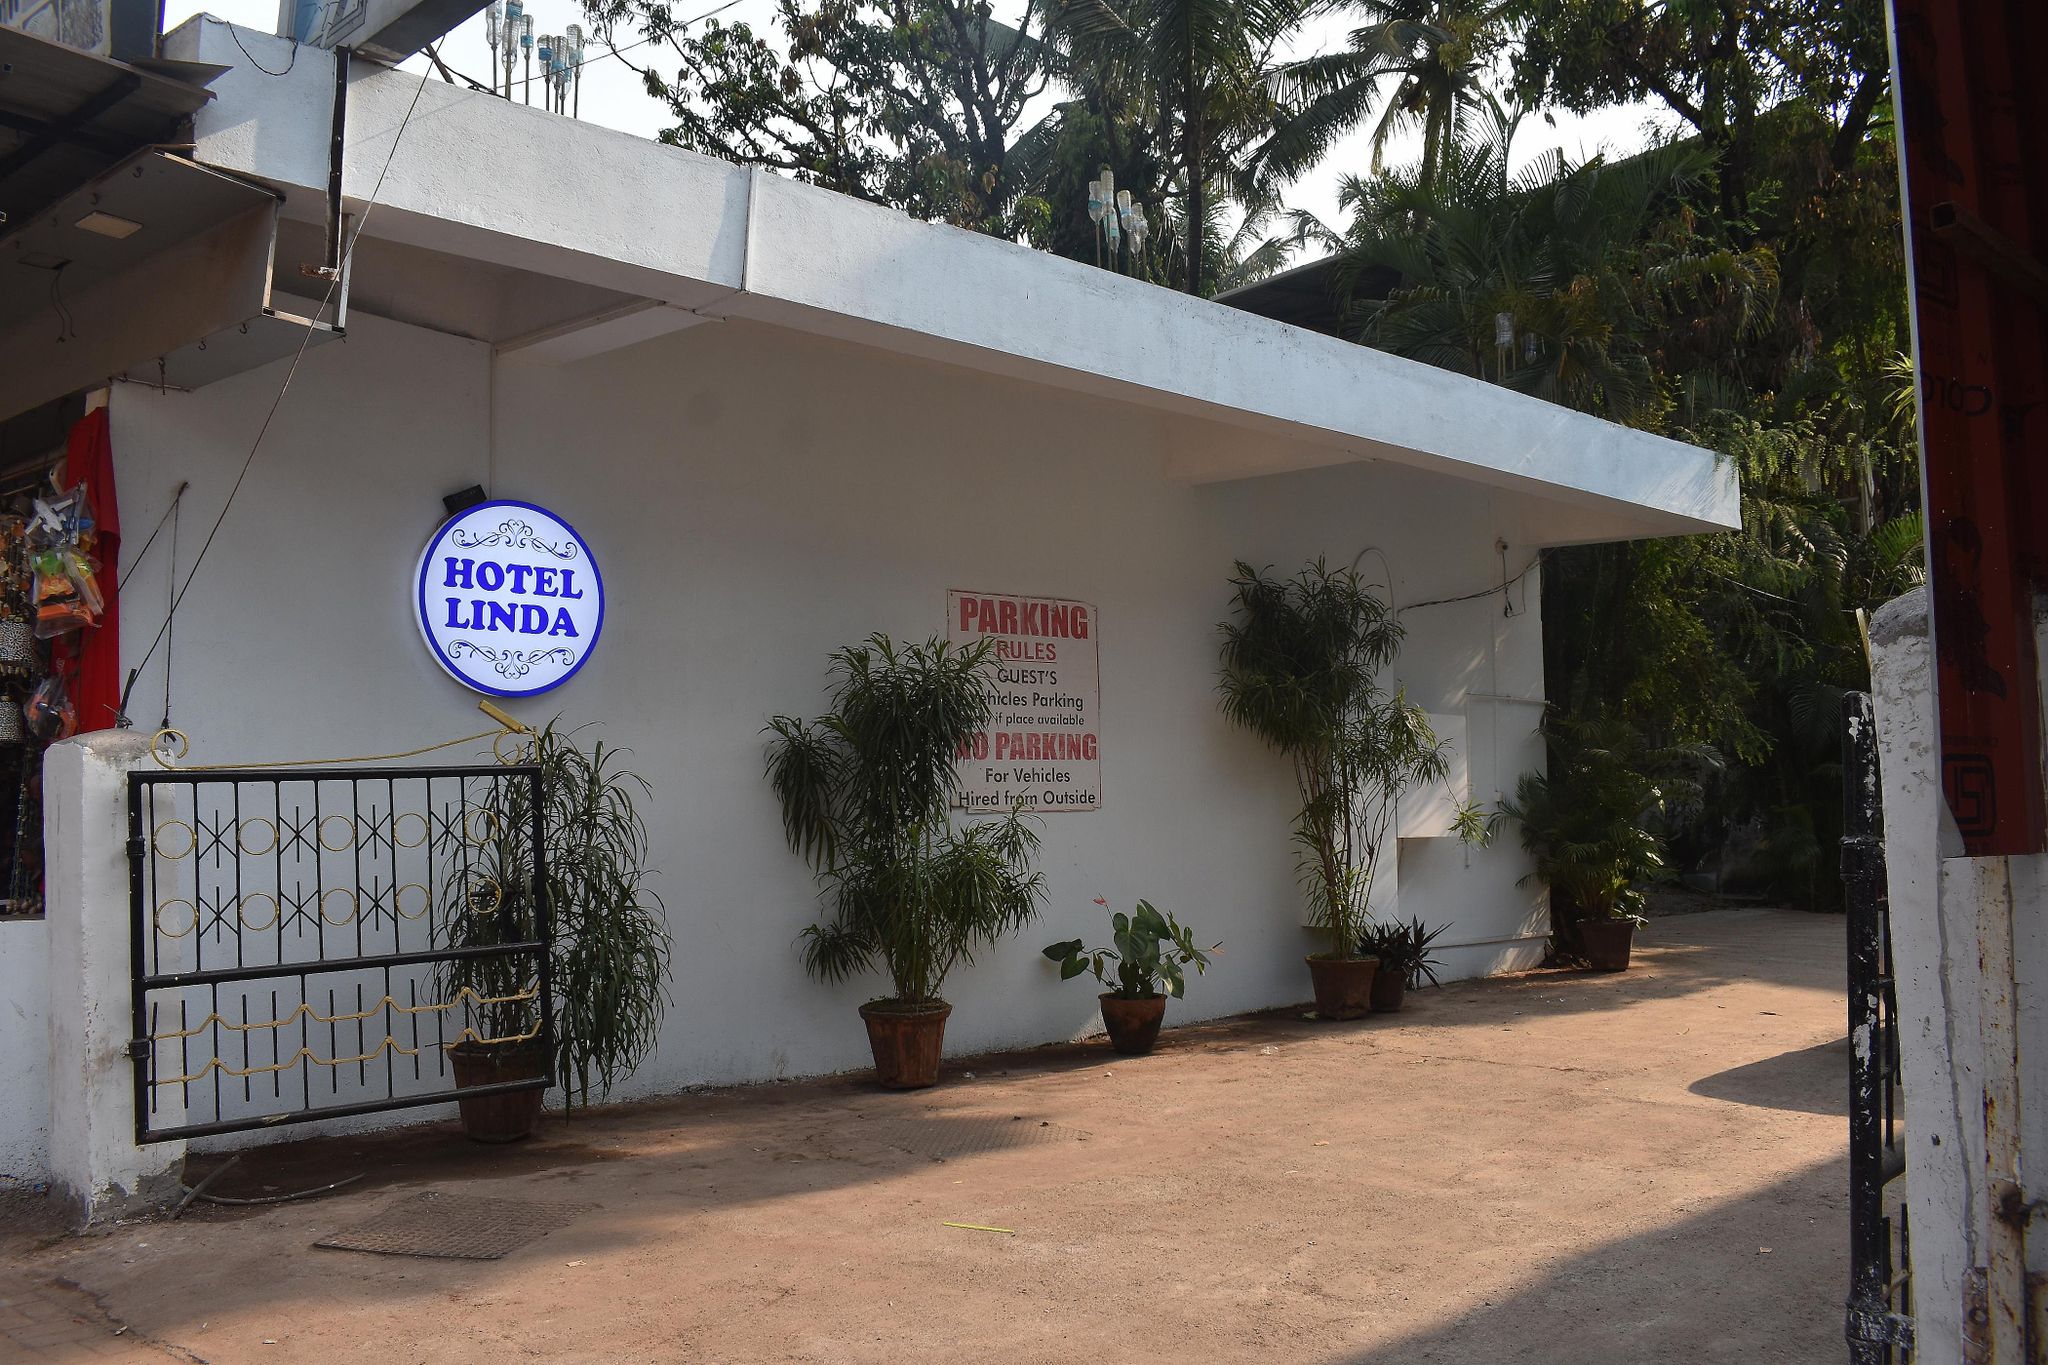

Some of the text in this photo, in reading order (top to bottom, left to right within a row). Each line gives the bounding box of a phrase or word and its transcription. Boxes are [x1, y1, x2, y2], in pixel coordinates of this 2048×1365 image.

[443, 557, 583, 599] HOTEL
[445, 597, 579, 637] LINDA
[959, 597, 1088, 639] PARKING
[996, 640, 1057, 660] RULES
[997, 668, 1057, 685] GUEST'S
[978, 689, 1084, 711] ehicles Parking
[995, 712, 1003, 725] if
[1006, 713, 1034, 727] place
[1037, 714, 1084, 725] available
[995, 731, 1097, 760] PARKING
[985, 768, 1071, 783] For Vehicles
[958, 789, 1096, 806] Hired from Outside
